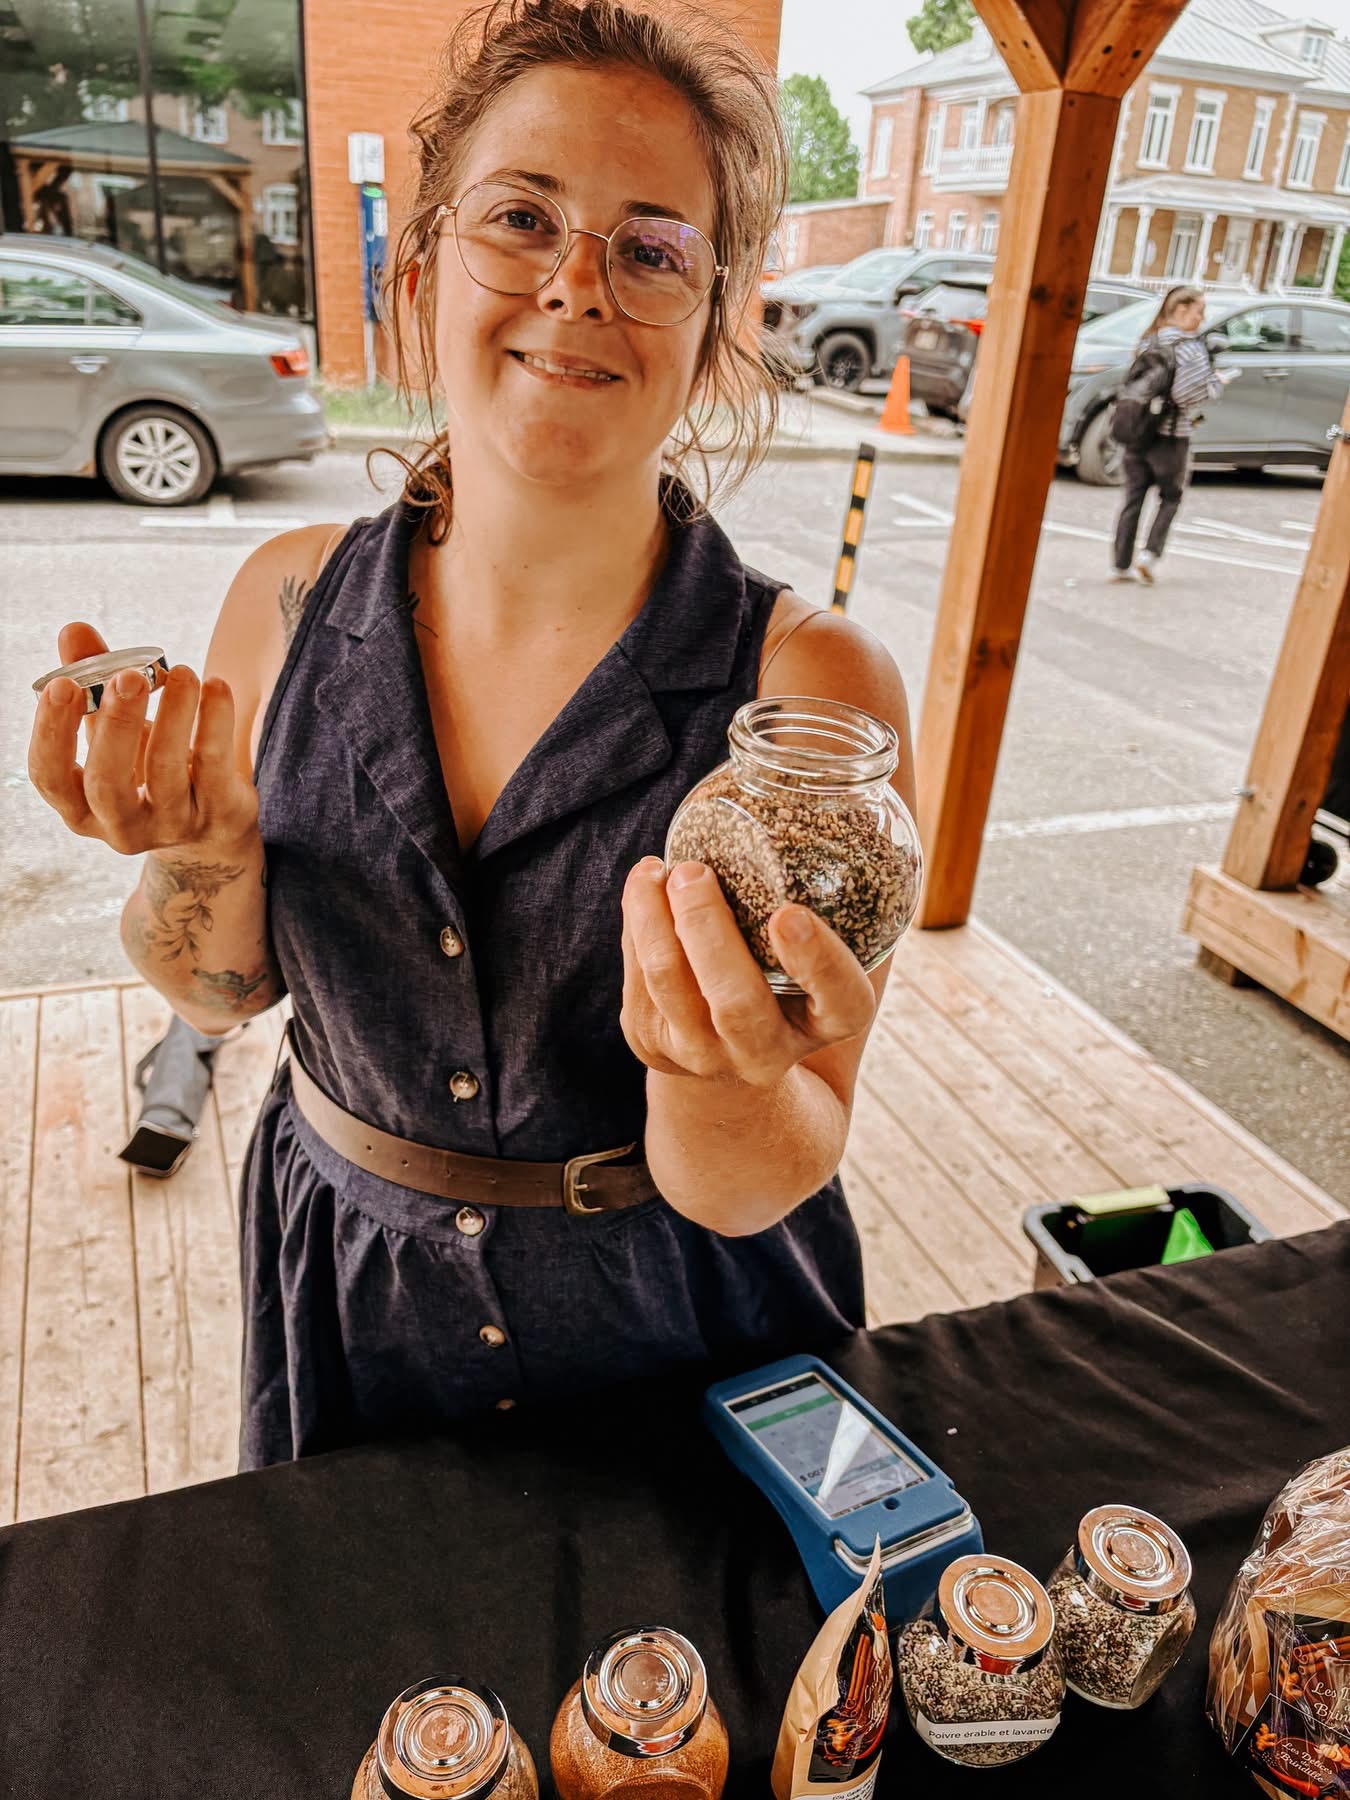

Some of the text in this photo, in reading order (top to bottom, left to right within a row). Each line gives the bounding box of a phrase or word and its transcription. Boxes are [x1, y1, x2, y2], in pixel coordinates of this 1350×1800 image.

[1311, 1682, 1337, 1698] Les
[928, 1727, 1054, 1739] Poivre érable et lavande
[1281, 1742, 1299, 1755] Les
